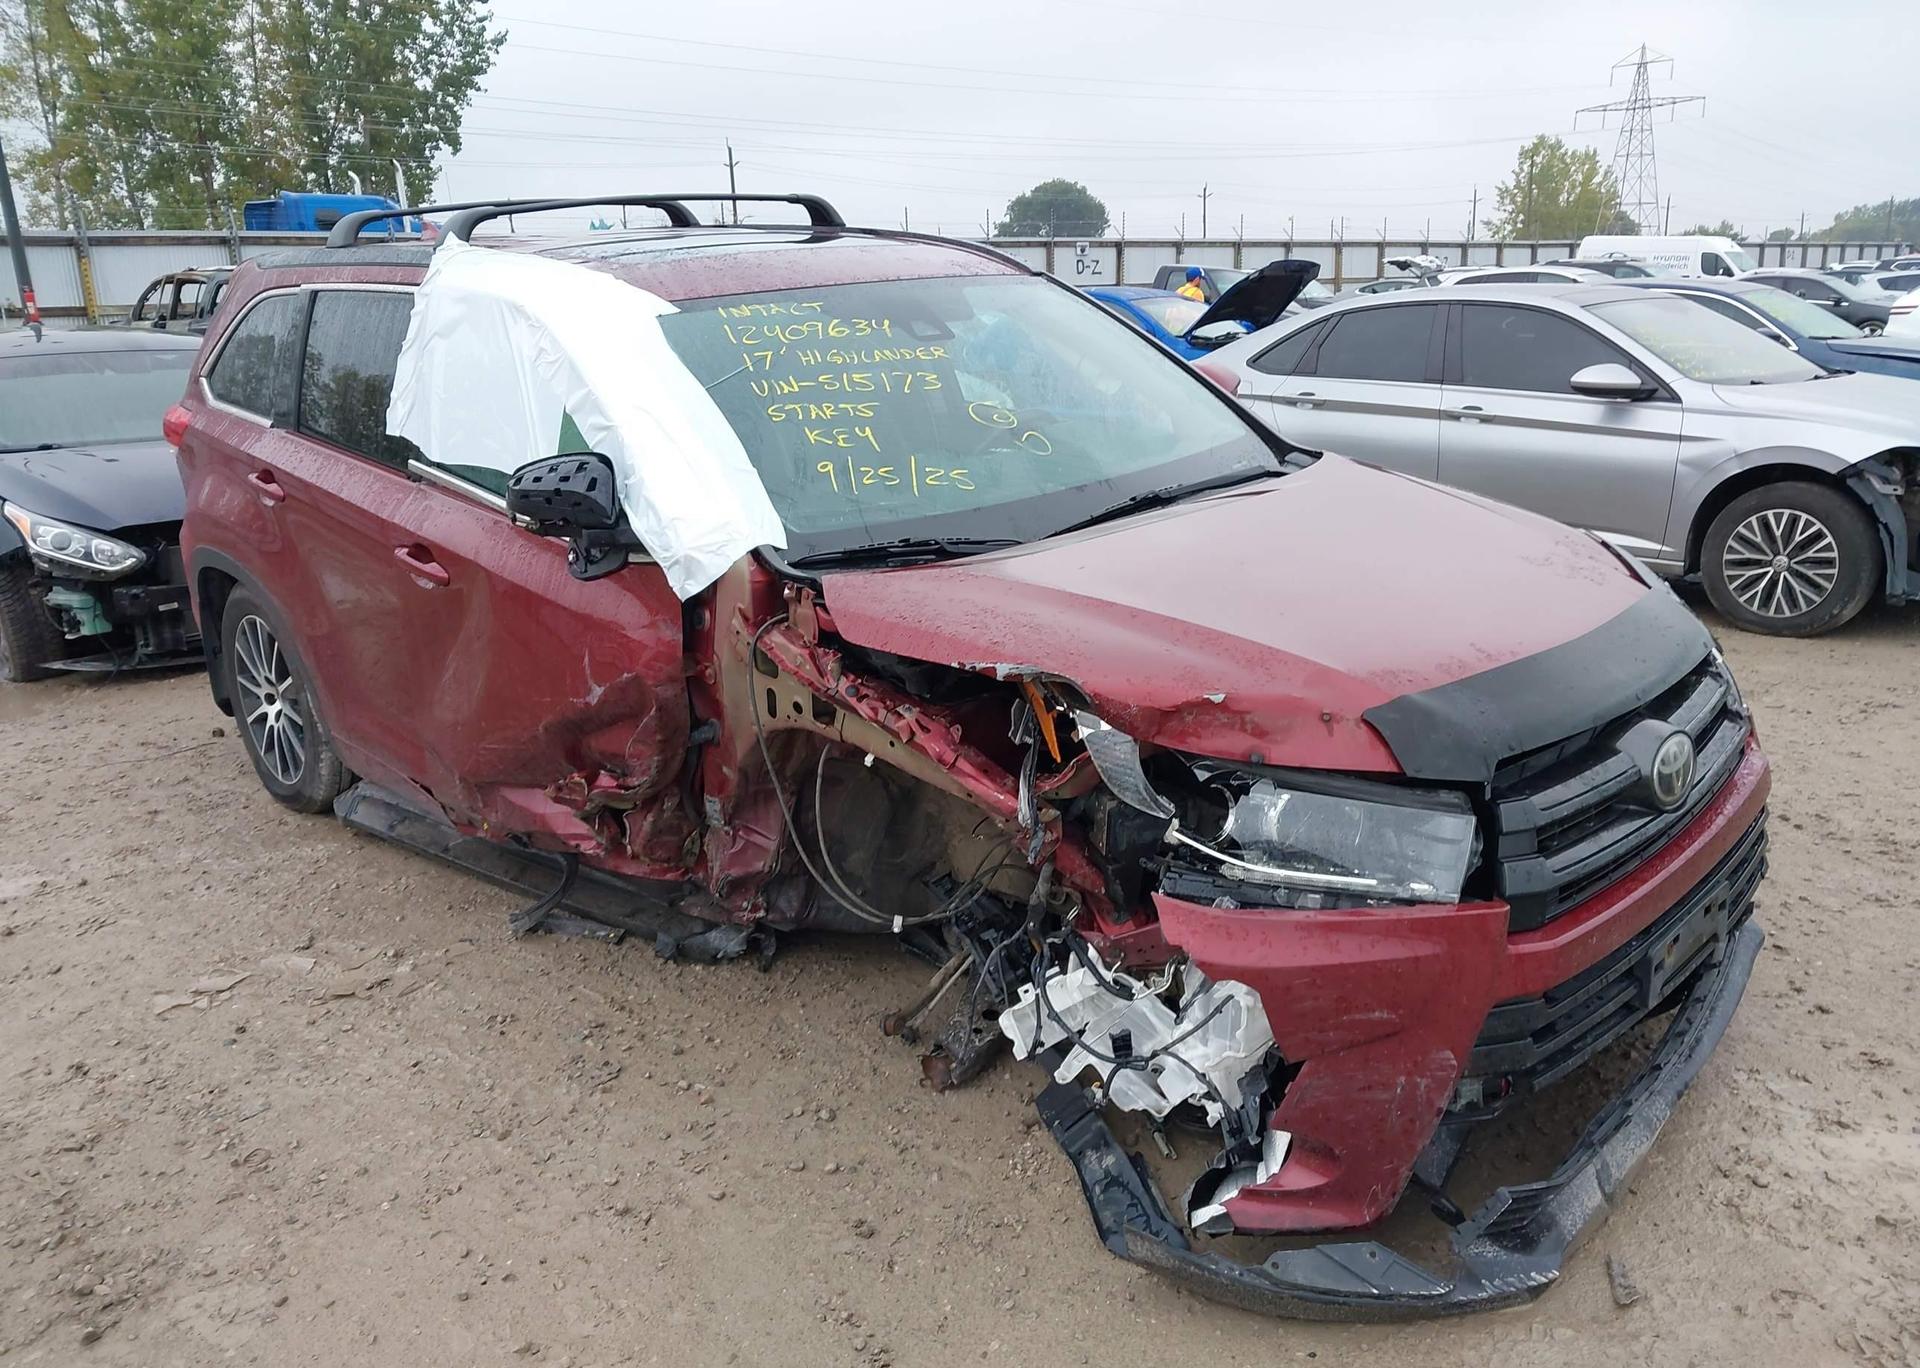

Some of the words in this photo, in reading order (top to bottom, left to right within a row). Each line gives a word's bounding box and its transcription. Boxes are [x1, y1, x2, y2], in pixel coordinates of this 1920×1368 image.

[1076, 259, 1102, 275] D-Z
[1653, 254, 1691, 263] HYUNDAI
[717, 302, 824, 319] INTACT
[723, 318, 893, 345] 12409634
[796, 346, 951, 366] HIGHLANDER
[767, 402, 881, 422] STARTS
[804, 426, 881, 453] KEY
[816, 455, 976, 497] 9/25/25
